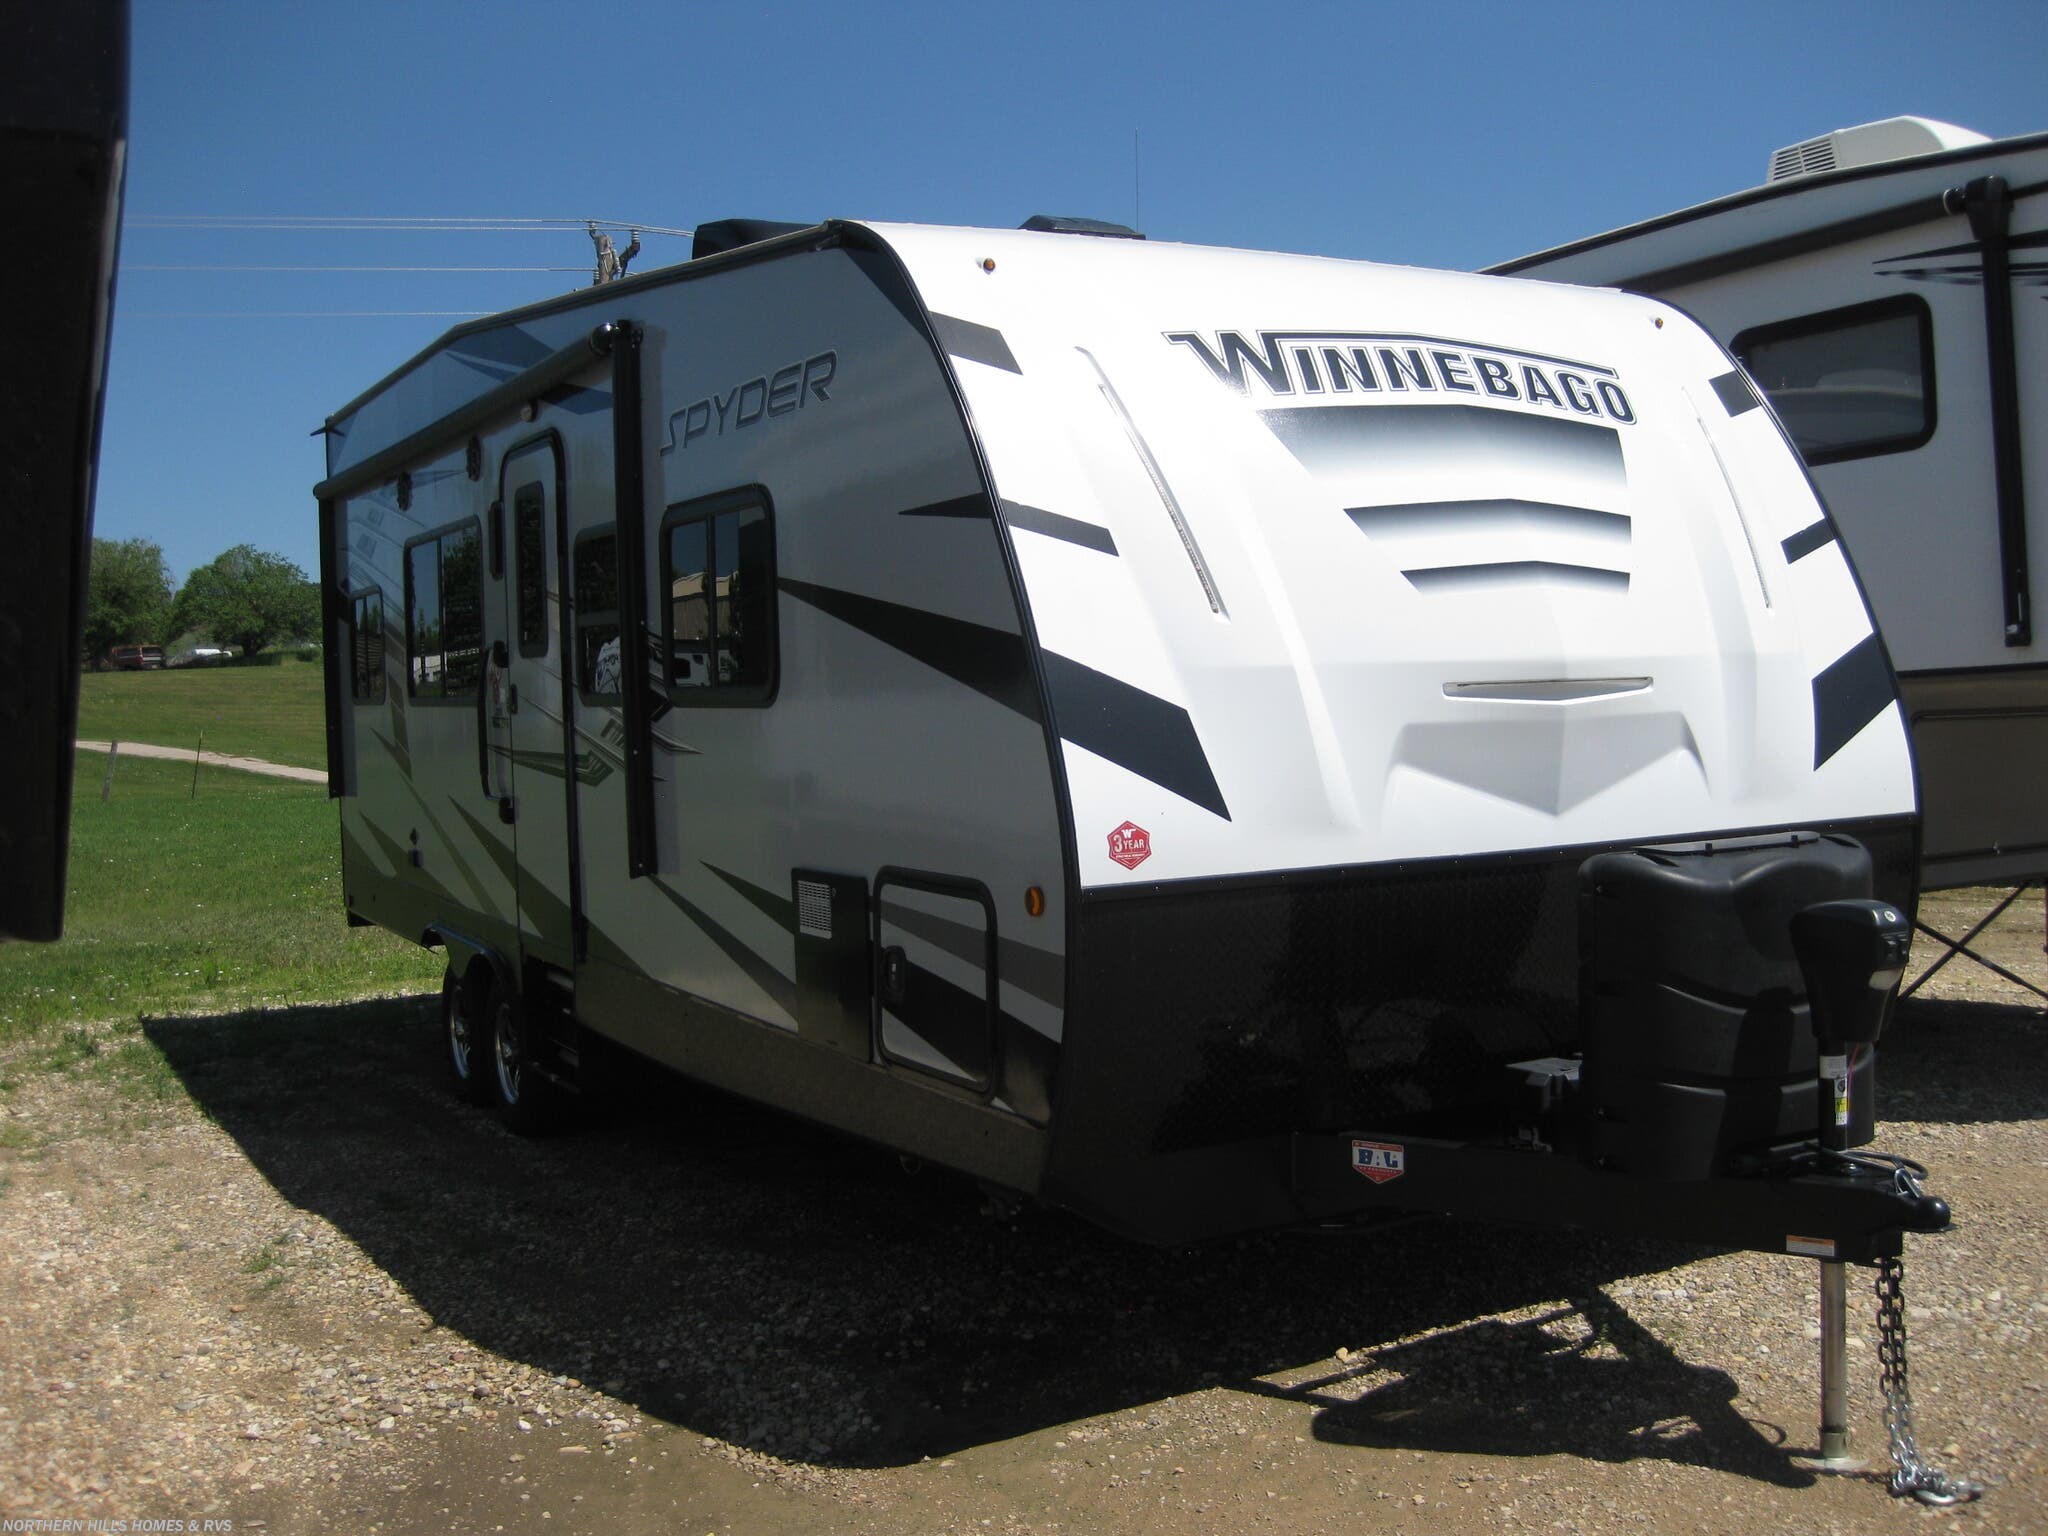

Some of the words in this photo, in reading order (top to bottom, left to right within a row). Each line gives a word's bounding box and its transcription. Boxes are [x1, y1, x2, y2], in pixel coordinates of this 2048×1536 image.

[660, 349, 837, 457] SPYDER
[1161, 329, 1637, 425] WINNEBAGO
[1113, 834, 1123, 853] 3
[1123, 838, 1145, 850] YEAR
